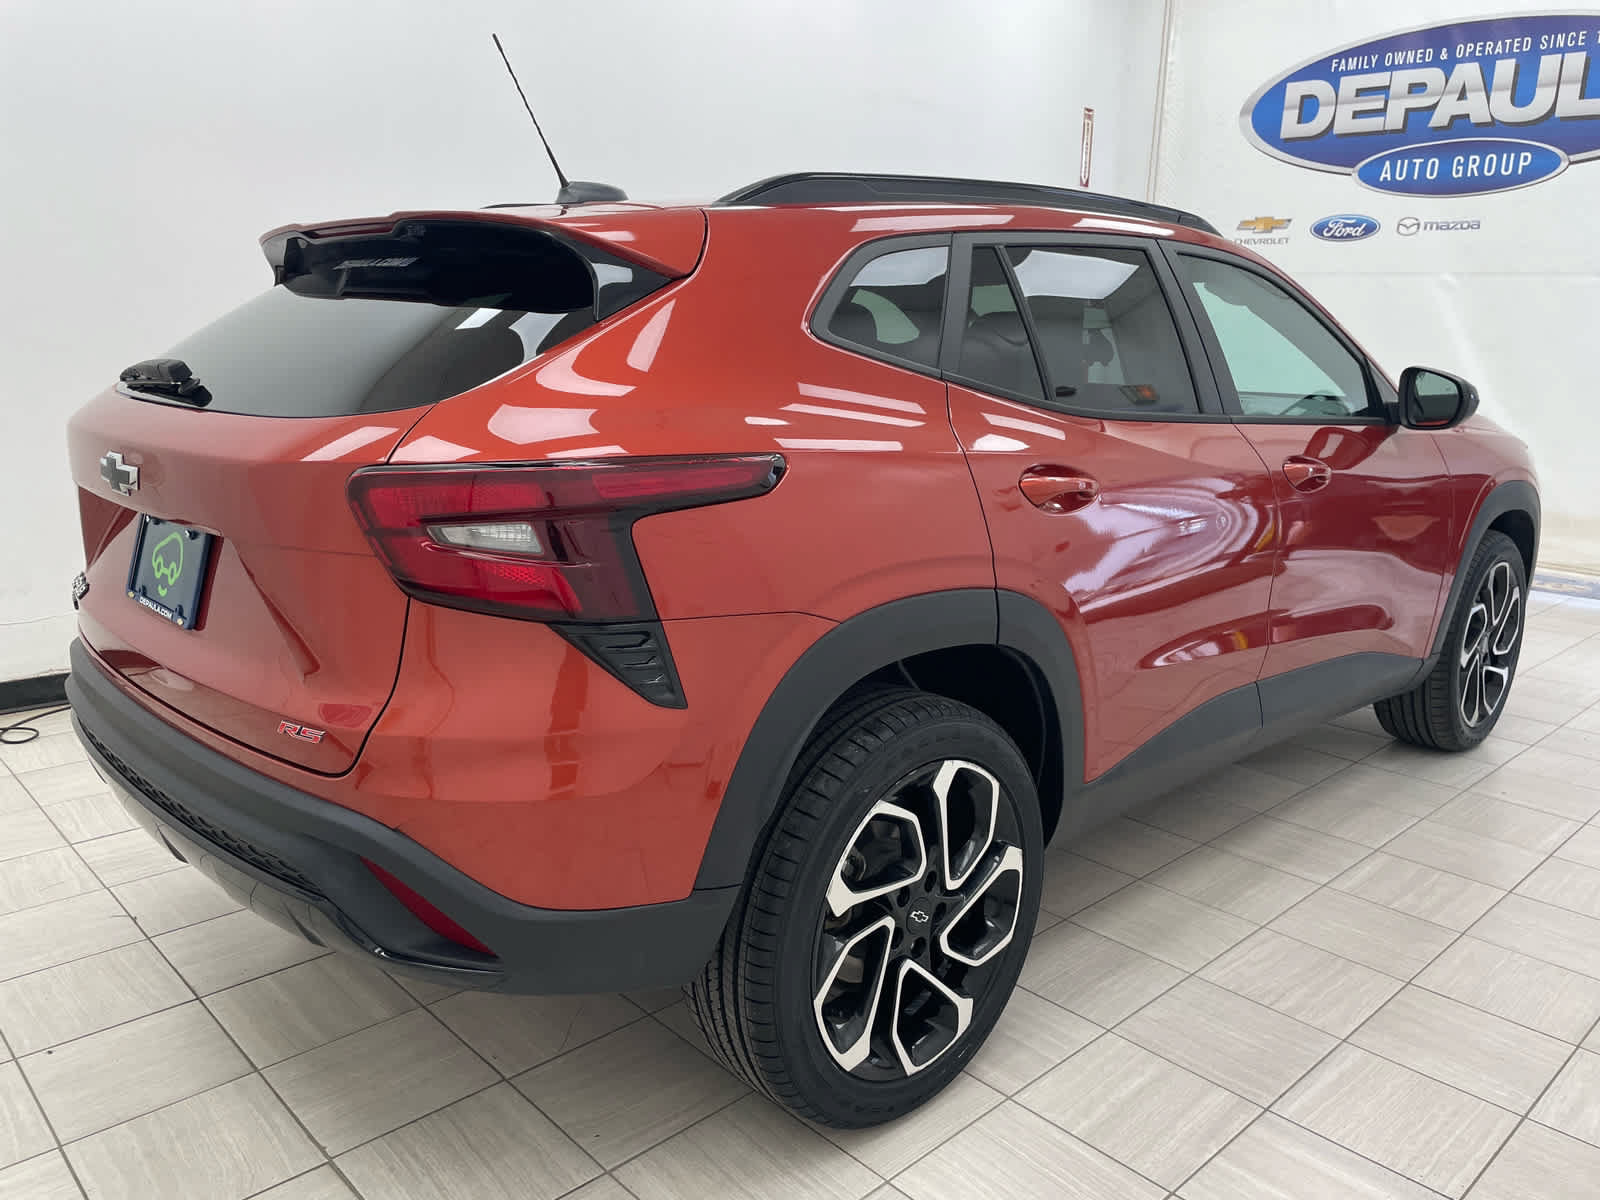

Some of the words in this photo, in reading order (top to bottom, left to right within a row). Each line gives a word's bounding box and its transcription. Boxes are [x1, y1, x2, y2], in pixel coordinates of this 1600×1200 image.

[1331, 54, 1379, 72] FAMILY
[1384, 48, 1433, 66] OWNED
[1440, 50, 1449, 61] &
[1456, 37, 1532, 58] OPERATED
[1540, 30, 1588, 50] SINCE
[1379, 157, 1439, 182] AUTO
[1452, 152, 1532, 177] GROUP
[1322, 218, 1367, 239] Ford
[1423, 218, 1481, 232] mazda
[277, 719, 326, 744] RS
